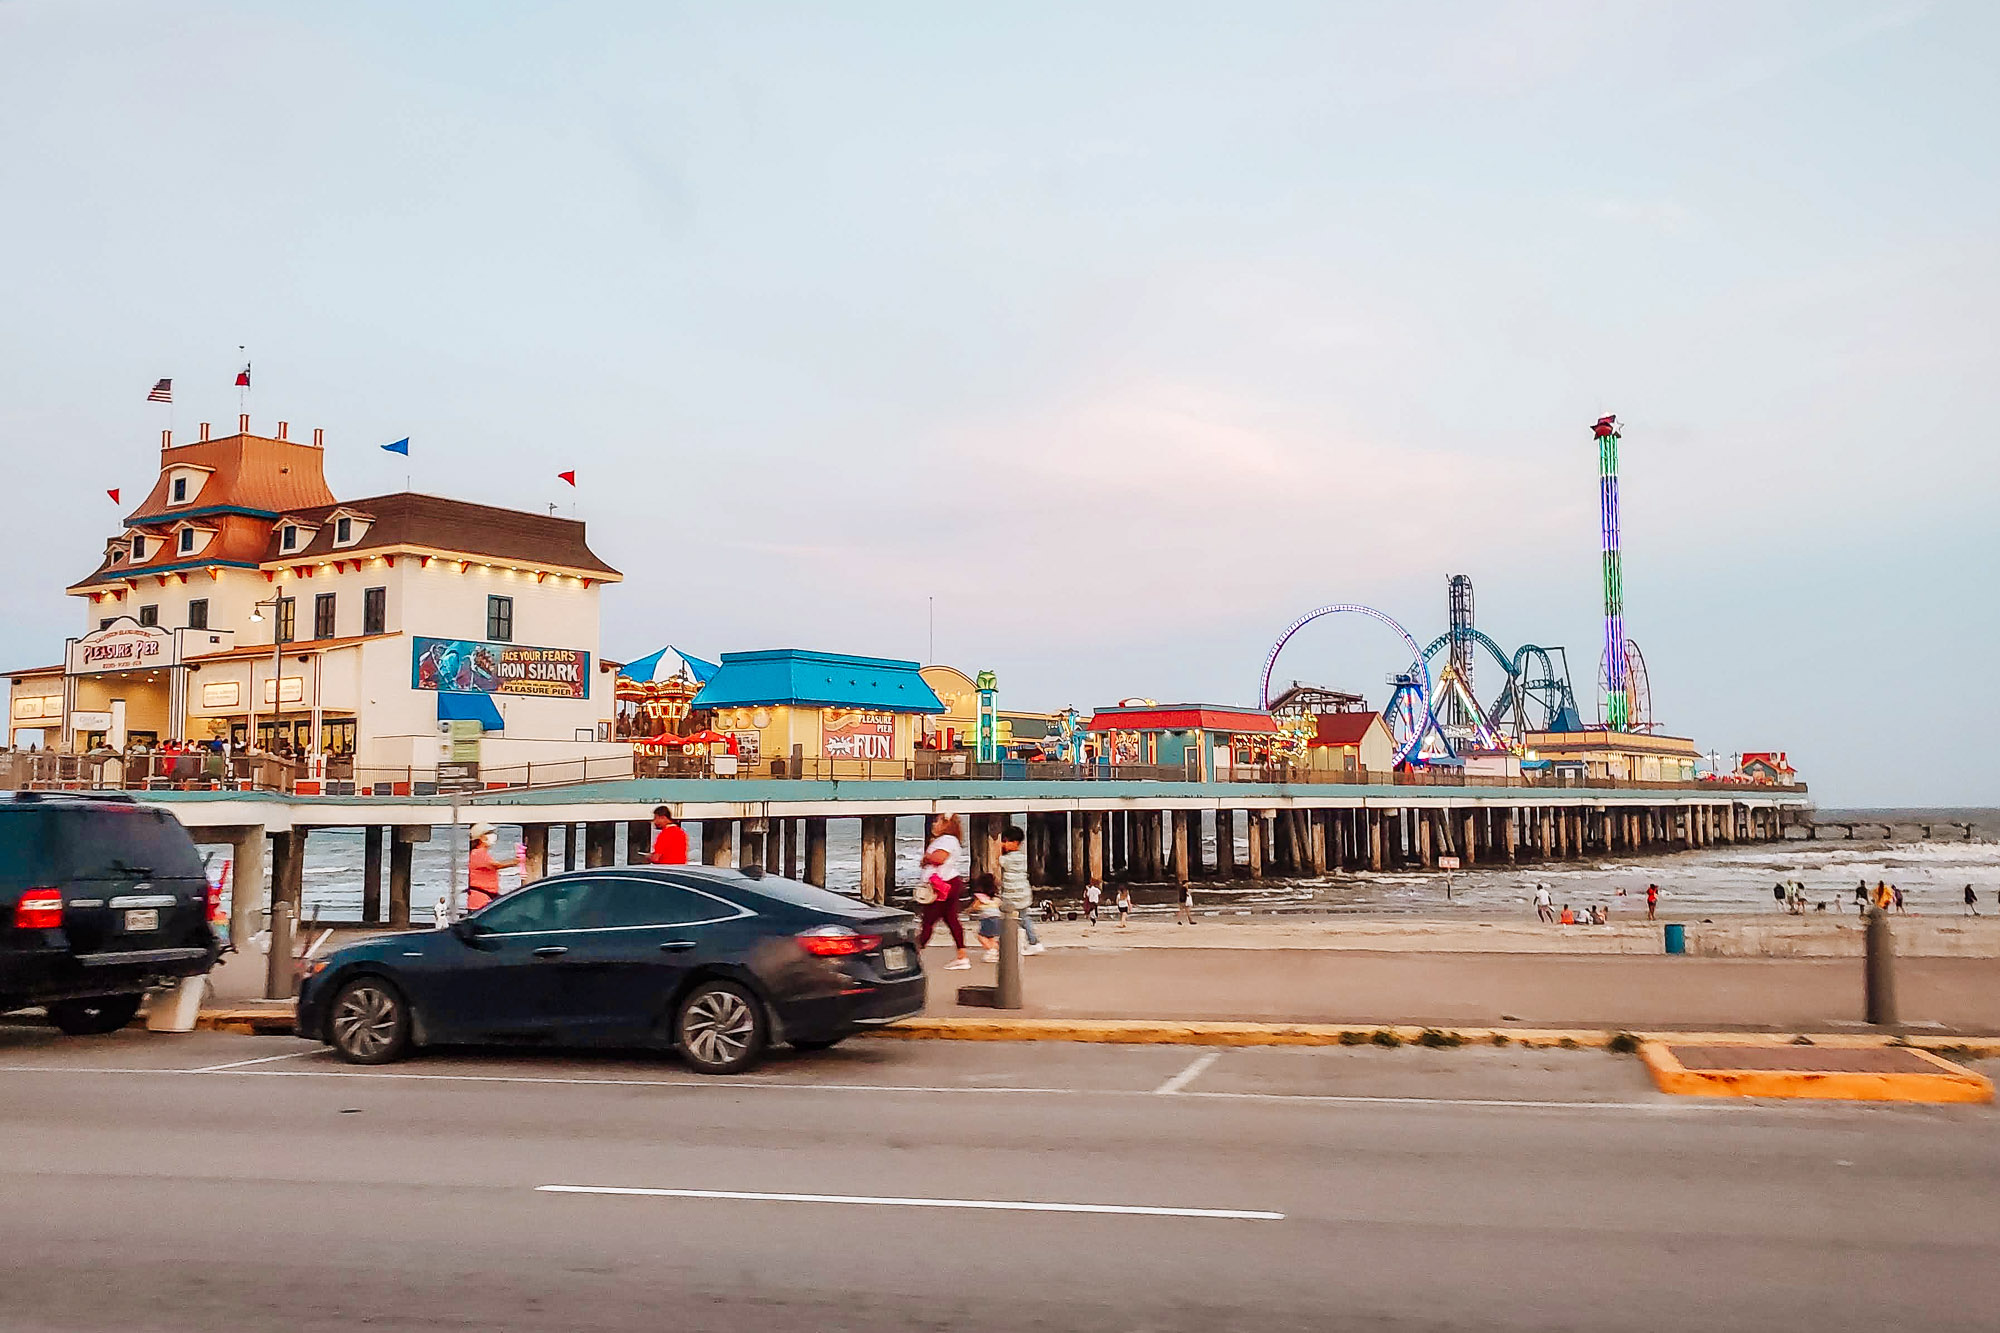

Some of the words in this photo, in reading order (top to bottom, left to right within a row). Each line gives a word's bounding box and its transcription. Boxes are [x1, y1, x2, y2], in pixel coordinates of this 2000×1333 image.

[84, 643, 133, 664] PLEASURE
[502, 651, 518, 662] FACE
[519, 651, 541, 662] YOUR
[542, 650, 576, 662] FEARS
[497, 662, 526, 679] IRON
[528, 663, 580, 682] SHARK
[504, 685, 550, 695] PLEASURE
[552, 688, 571, 696] PIER
[858, 714, 892, 724] PLEASURE
[877, 724, 893, 733] PIER
[852, 734, 891, 759] FUN
